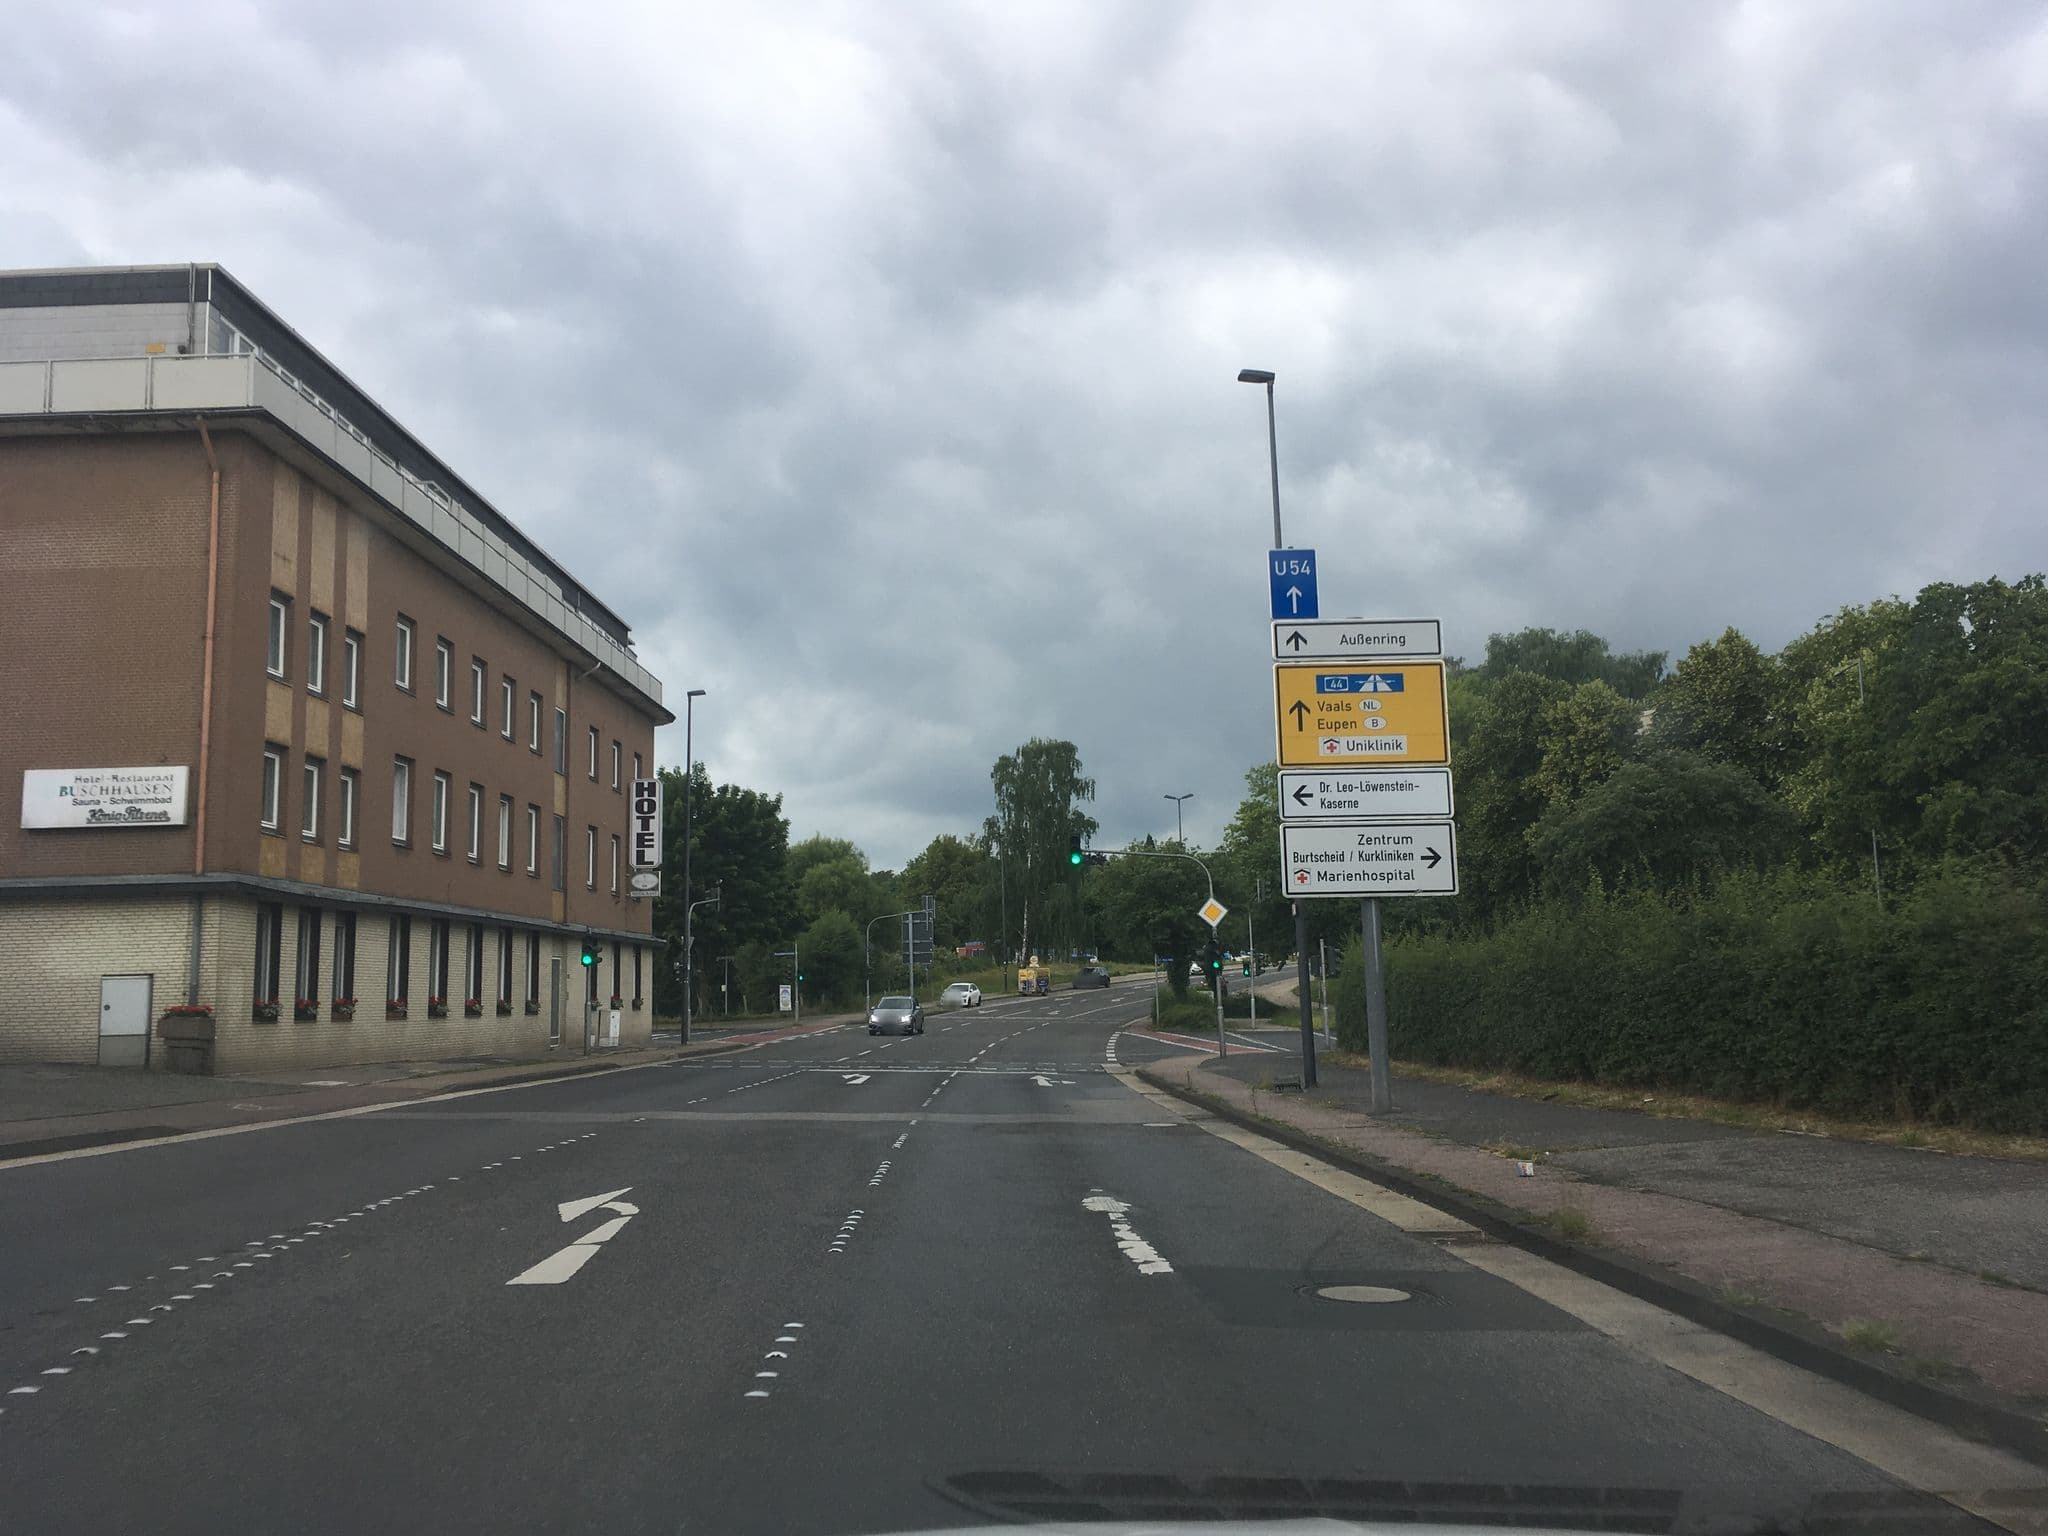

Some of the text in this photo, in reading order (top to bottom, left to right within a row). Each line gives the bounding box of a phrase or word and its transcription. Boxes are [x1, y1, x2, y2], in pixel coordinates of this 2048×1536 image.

[1339, 633, 1406, 646] Außenring
[1330, 679, 1343, 689] 44
[1317, 701, 1378, 712] Vaals NL
[1317, 718, 1379, 732] Eupen B
[1346, 739, 1403, 752] Uniklinik
[59, 783, 173, 797] BUSCHHAUSEN
[1319, 780, 1420, 793] Dr. Leo-Löwenstein-
[72, 798, 100, 806] Sauna
[109, 796, 172, 805] Schwimmbad
[1320, 798, 1359, 809] Kaserne
[635, 781, 656, 866] HOTEL
[1357, 834, 1413, 845] Zentrum
[1293, 852, 1345, 863] Burtscheid
[1358, 850, 1414, 862] Kurkliniken
[1317, 869, 1415, 883] Marienhospital
